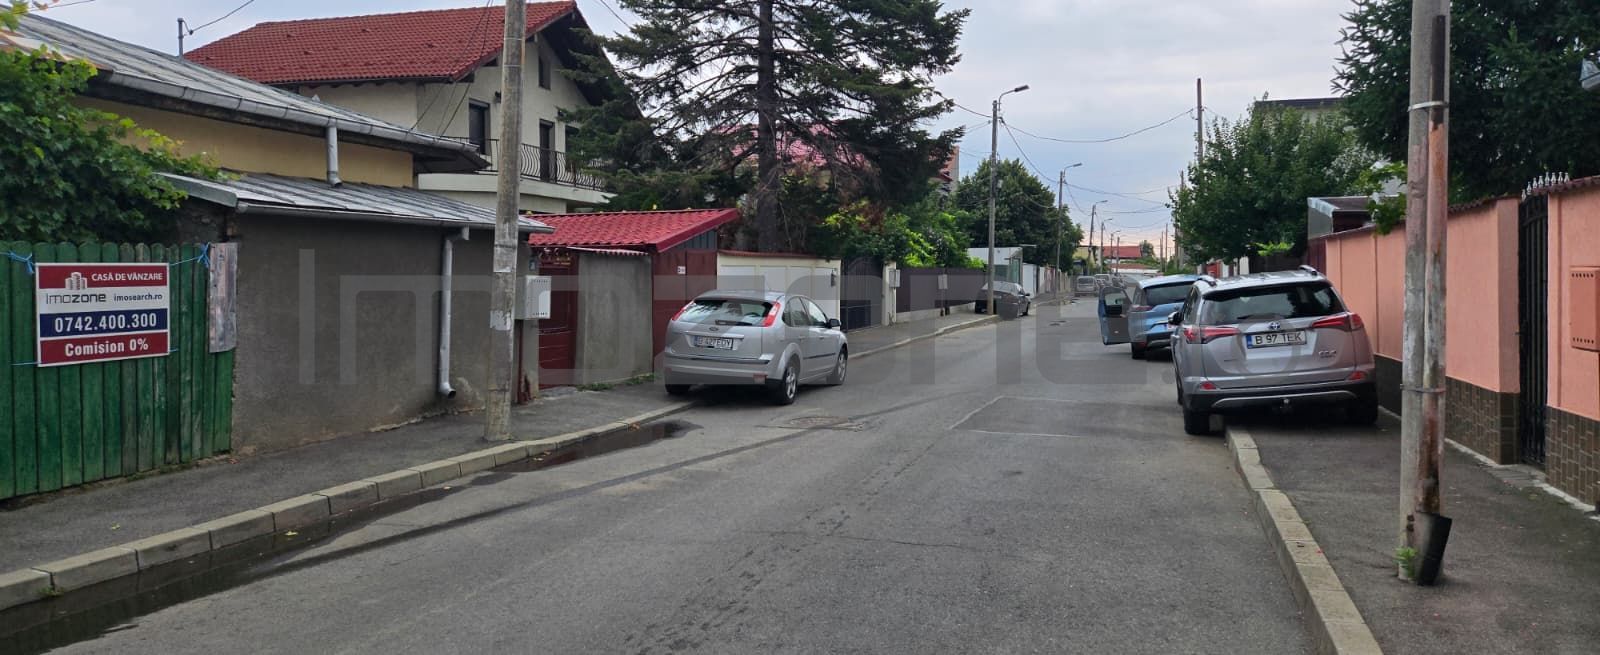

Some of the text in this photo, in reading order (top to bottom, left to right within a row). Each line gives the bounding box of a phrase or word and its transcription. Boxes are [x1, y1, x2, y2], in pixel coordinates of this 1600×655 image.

[114, 293, 162, 301] imosearch.ro
[55, 313, 157, 332] 0742.400.300
[1255, 332, 1302, 344] B 97 TEK
[65, 338, 149, 357] Comision 0%
